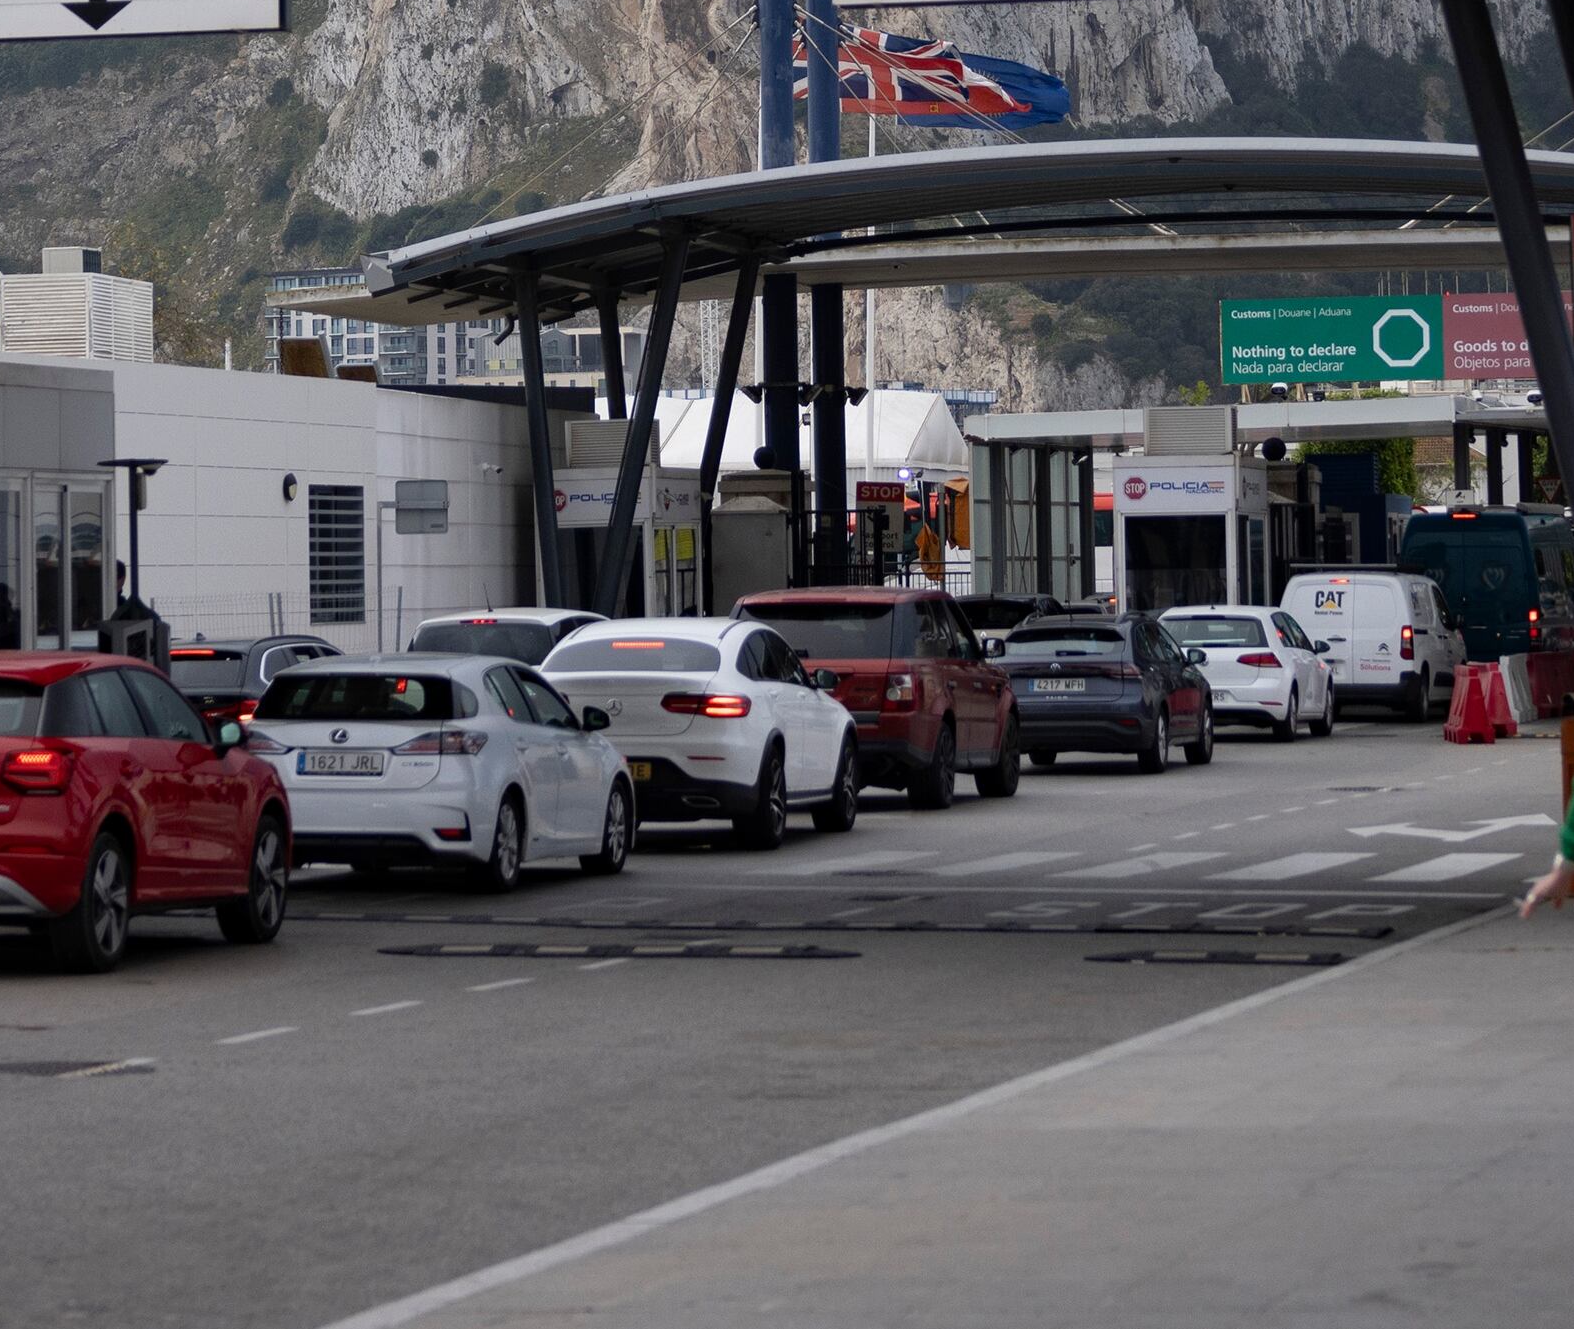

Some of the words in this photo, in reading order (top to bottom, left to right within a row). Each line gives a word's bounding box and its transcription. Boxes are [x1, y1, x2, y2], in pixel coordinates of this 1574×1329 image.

[1231, 309, 1271, 319] Customs
[1278, 308, 1312, 318] Douane
[1318, 307, 1352, 317] Aduana
[1452, 303, 1493, 313] Customs
[1500, 302, 1519, 312] Dou
[1232, 344, 1286, 359] Nothing
[1290, 345, 1305, 357] to
[1308, 343, 1357, 356] declare
[1453, 339, 1497, 353] Goods
[1502, 340, 1516, 352] to
[1232, 361, 1264, 374] Nada
[1267, 362, 1294, 375] para
[1297, 359, 1345, 373] declarar
[1453, 355, 1501, 371] Objetos
[1504, 356, 1531, 370] para
[861, 485, 901, 499] STOP
[1125, 482, 1145, 492] STOP
[1149, 481, 1209, 490] POLICIA
[1315, 590, 1345, 608] CAT
[1360, 663, 1391, 672] Solutions
[1036, 679, 1061, 690] 4217
[1064, 679, 1084, 689] MFH
[310, 755, 345, 770] 1621
[350, 756, 379, 770] JRL
